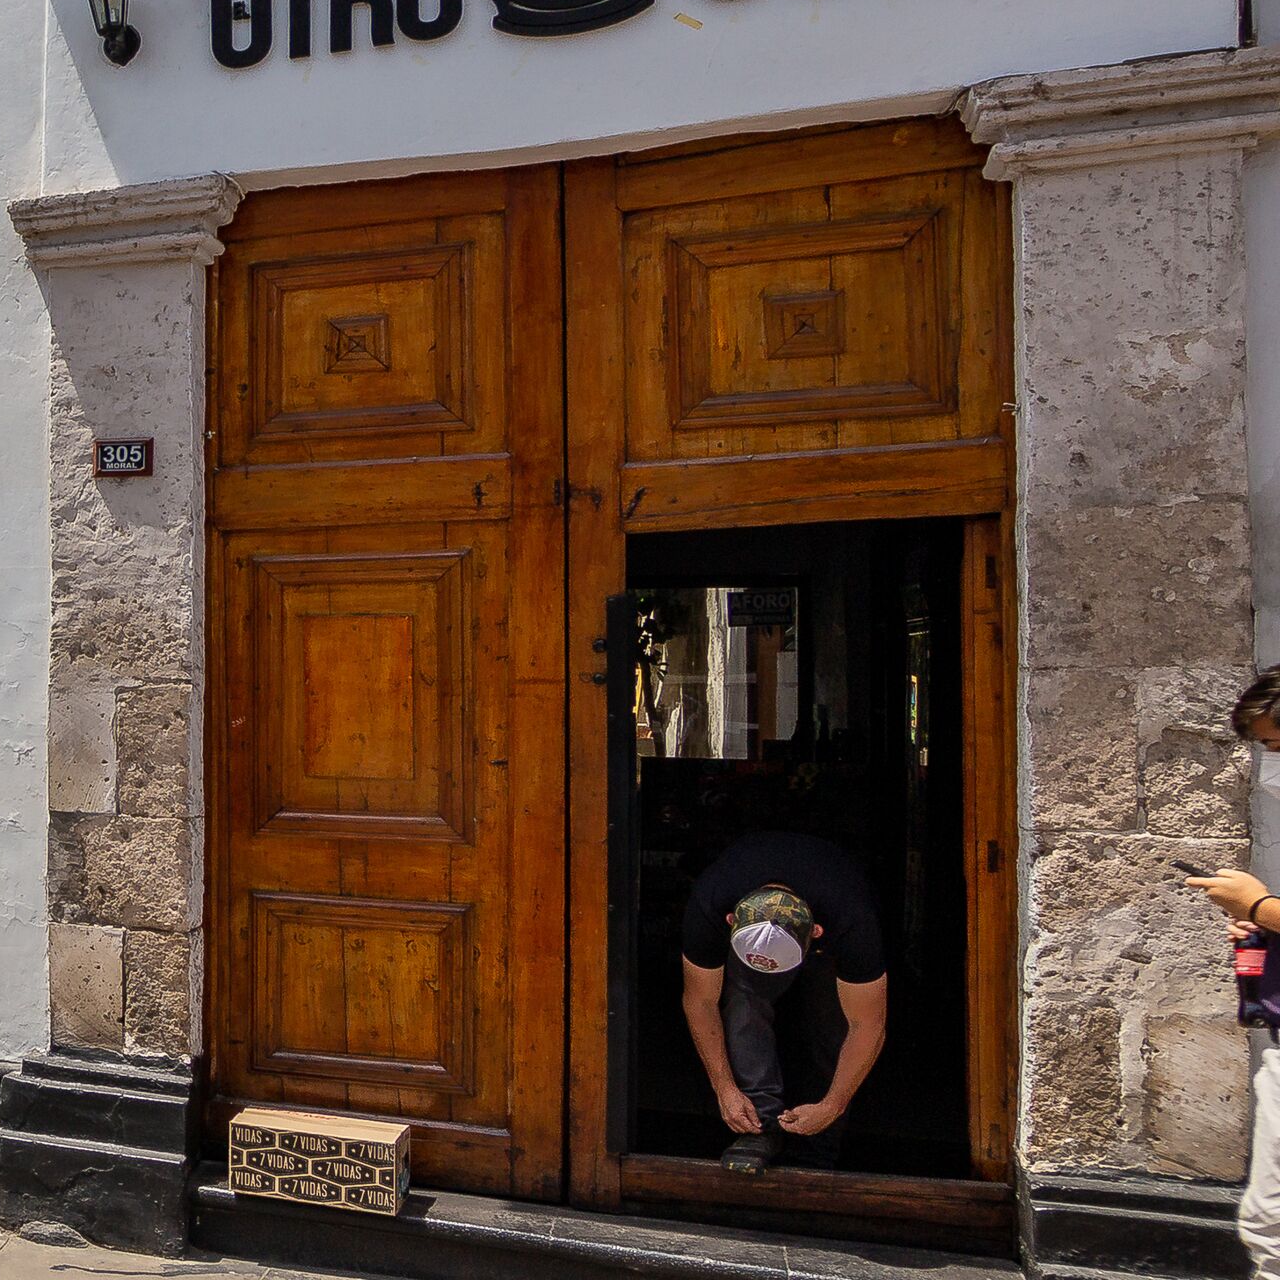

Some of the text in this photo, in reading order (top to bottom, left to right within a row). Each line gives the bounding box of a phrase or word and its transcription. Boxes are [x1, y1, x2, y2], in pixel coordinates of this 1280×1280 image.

[103, 446, 142, 463] 305
[731, 593, 790, 609] AFORO
[235, 1127, 262, 1144] VIDAS
[292, 1135, 328, 1153] 7 VIDAS
[260, 1153, 295, 1170] 7 VIDAS
[360, 1144, 394, 1162] 7 VIDAS
[326, 1162, 361, 1179] 7 VIDAS
[235, 1171, 262, 1188] VIDAS
[292, 1180, 328, 1197] 7 VIDAS
[360, 1189, 394, 1207] 7 VIDAS
